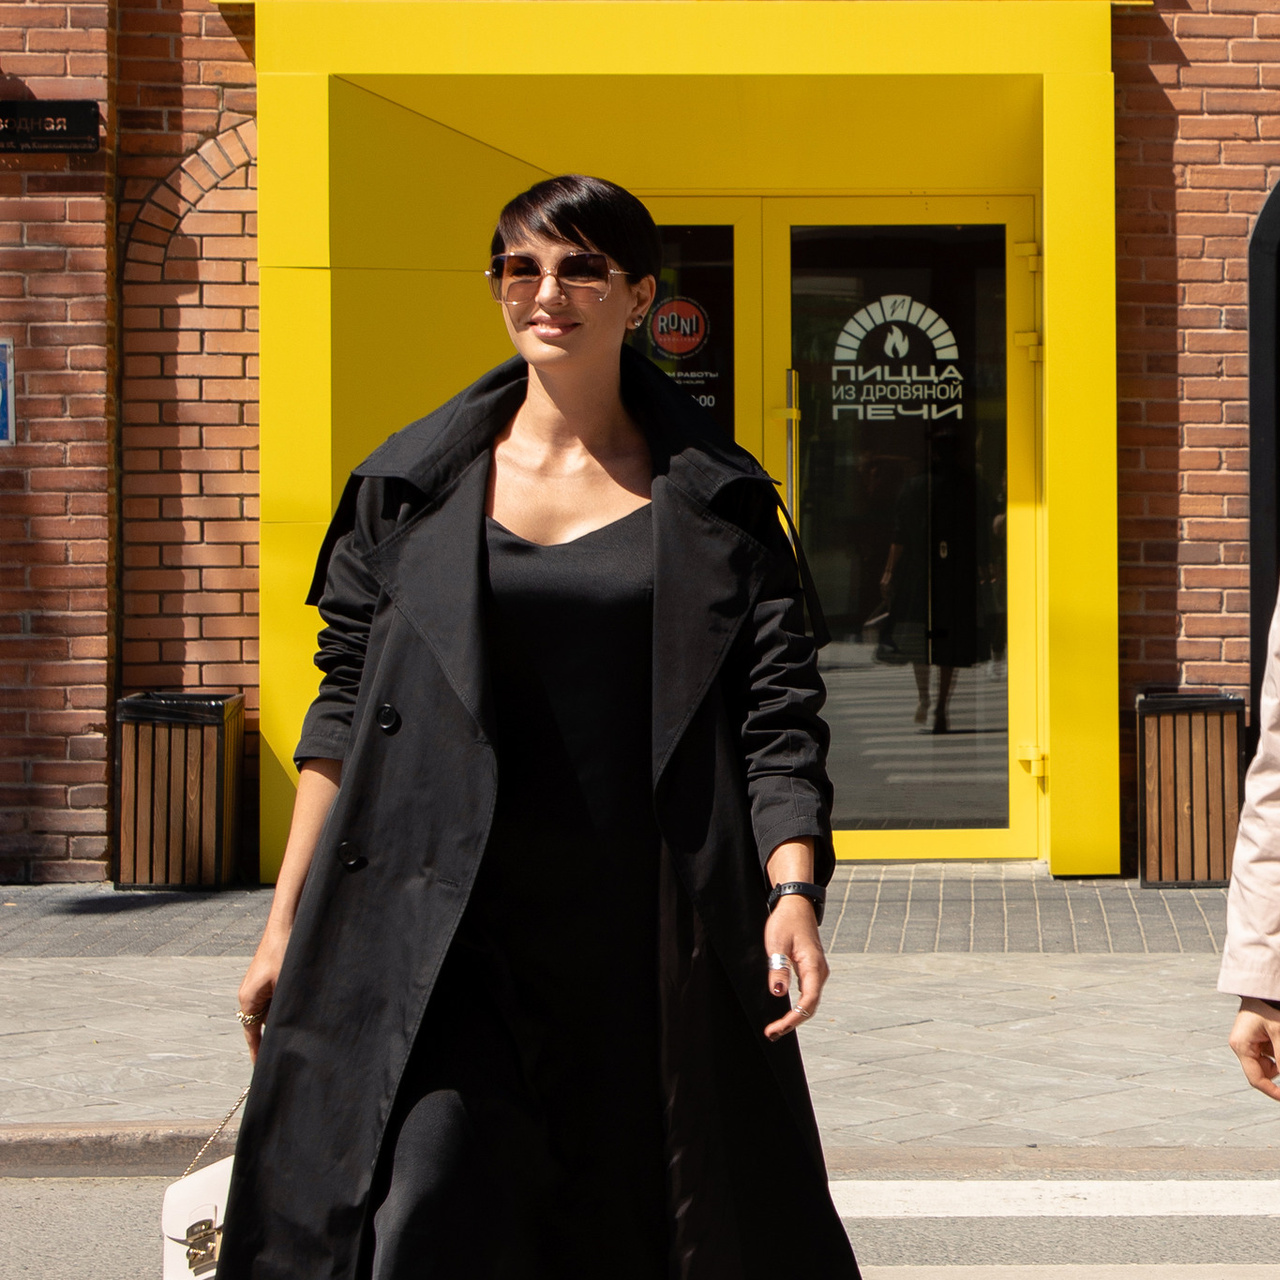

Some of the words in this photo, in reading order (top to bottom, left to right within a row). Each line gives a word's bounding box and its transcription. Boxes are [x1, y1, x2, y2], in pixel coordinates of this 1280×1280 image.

[658, 311, 697, 336] RONI
[831, 364, 965, 384] ПИЦЦА
[832, 384, 857, 401] ИЗ
[860, 380, 963, 403] ДРОВЯНОЙ
[832, 403, 964, 421] ПЕЧИ
